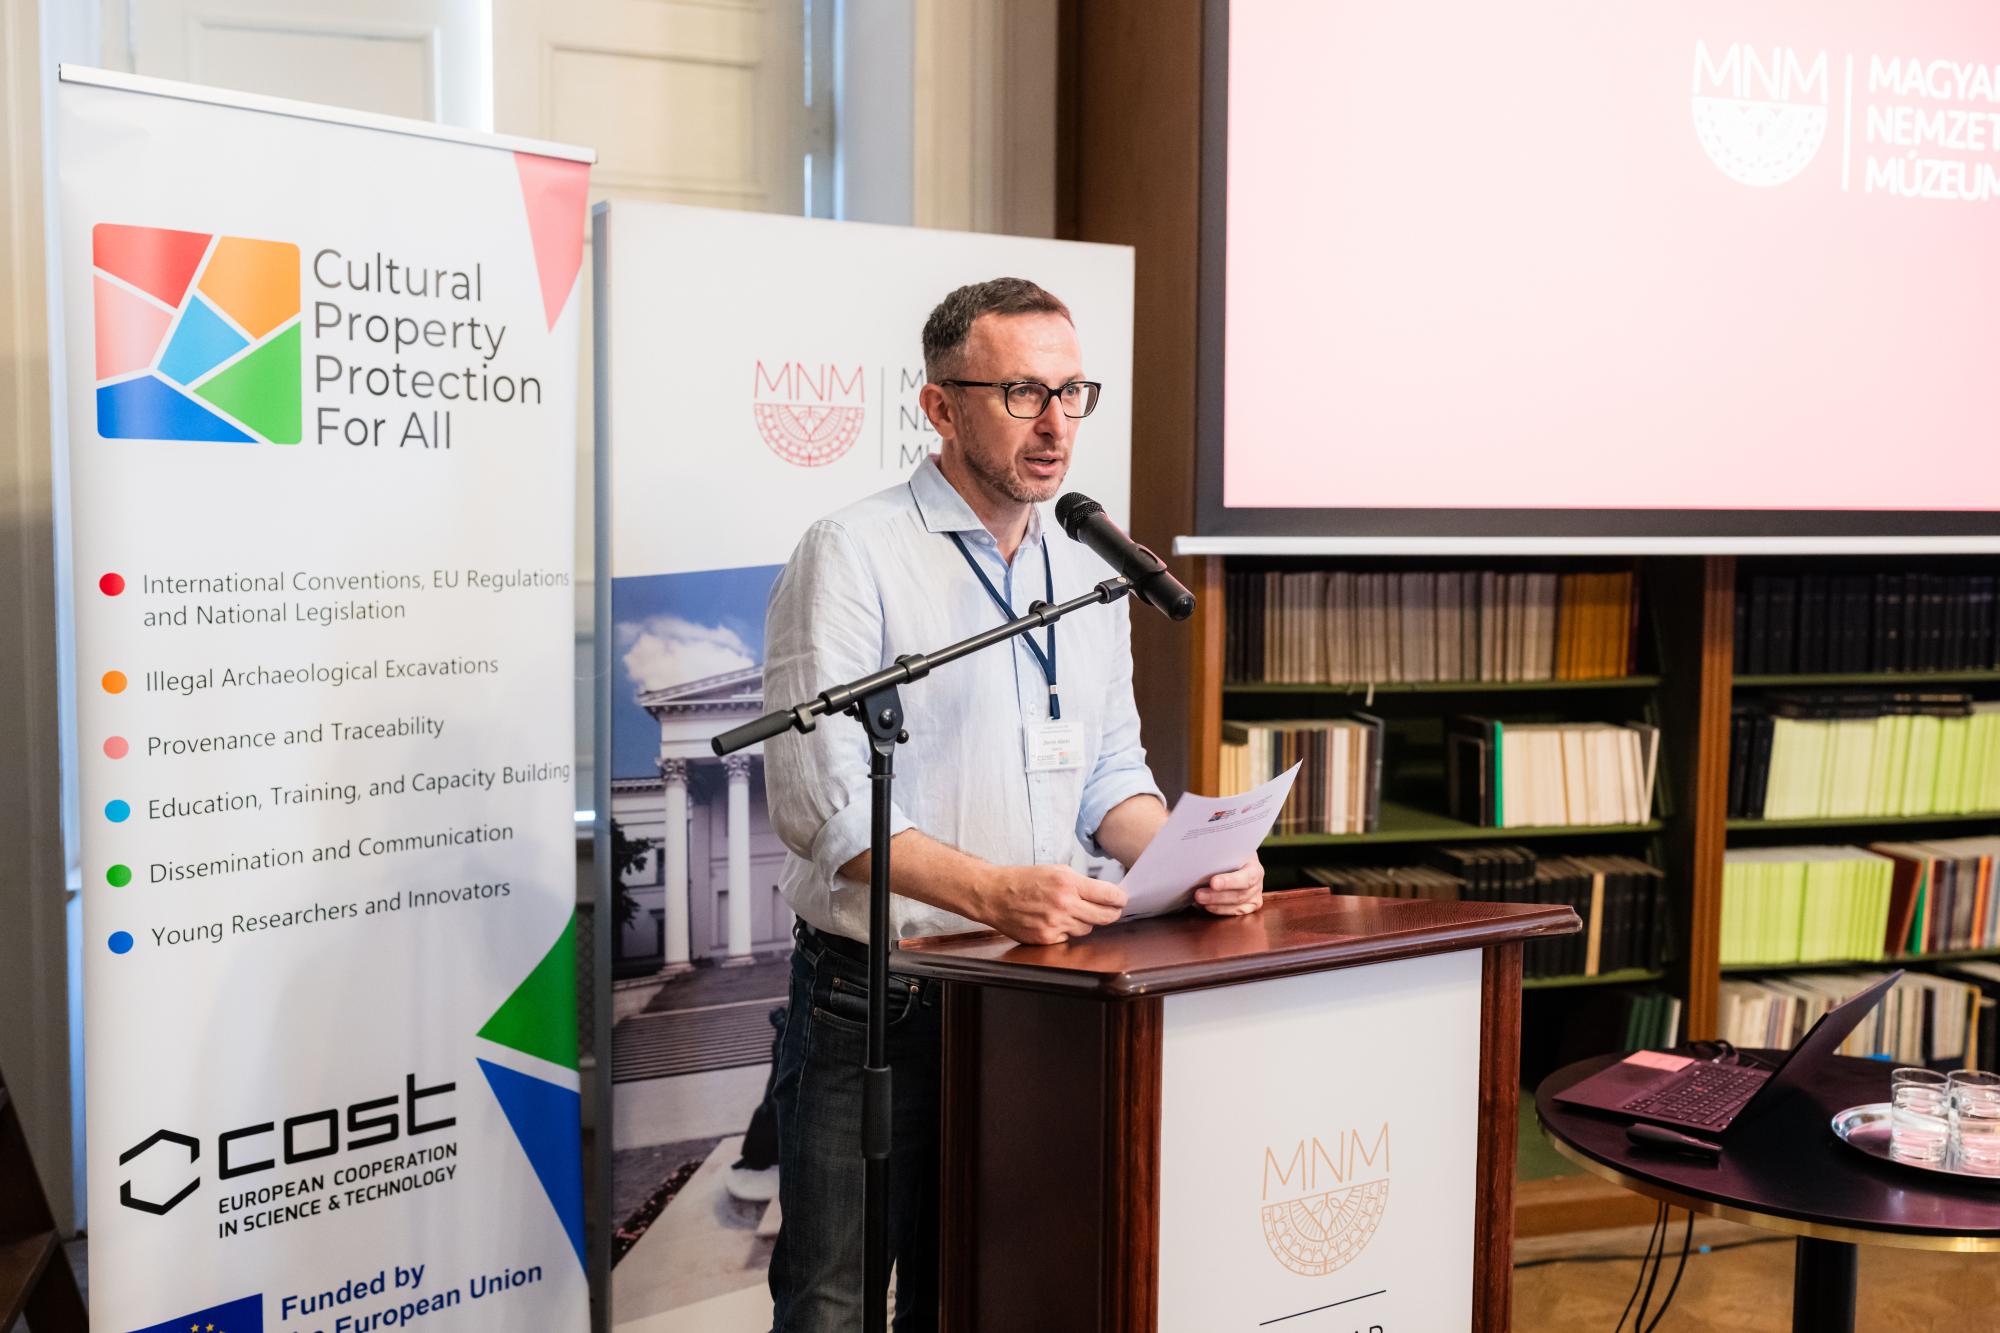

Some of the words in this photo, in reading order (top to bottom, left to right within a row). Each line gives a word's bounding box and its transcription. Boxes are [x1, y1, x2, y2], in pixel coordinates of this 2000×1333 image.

[1692, 39, 1827, 104] MNM
[313, 248, 482, 302] Cultural
[313, 301, 507, 359] Property
[314, 354, 542, 404] Protection
[754, 360, 865, 403] MNM
[316, 408, 387, 447] For
[399, 411, 452, 449] All
[143, 573, 285, 593] International
[292, 571, 425, 590] Conventions,
[433, 570, 459, 588] EU
[466, 569, 569, 591] Regulations
[143, 605, 187, 626] and
[196, 602, 287, 624] National
[295, 600, 406, 625] Legislation
[146, 668, 213, 694] Illegal
[221, 661, 378, 686] Archaeological
[385, 656, 499, 676] Excavations
[147, 729, 276, 755] Provenance
[283, 723, 323, 743] and
[330, 716, 445, 740] Traceability
[148, 792, 263, 819] Education,
[270, 781, 361, 805] Training,
[368, 775, 406, 795] and
[412, 768, 495, 793] Capacity
[503, 761, 570, 783] Building
[150, 848, 304, 883] Dissemination
[312, 839, 351, 860] and
[358, 824, 514, 856] Communication
[151, 919, 224, 946] Young
[232, 899, 358, 933] Researchers
[364, 893, 401, 914] and
[407, 880, 511, 906] Innovators
[219, 1175, 325, 1214] EUROPEAN
[333, 1143, 458, 1186] COOPERATION
[1262, 1121, 1390, 1201] MNM
[219, 1223, 238, 1238] IN
[243, 1200, 321, 1233] SCIENCE
[327, 1195, 340, 1211] &
[345, 1165, 458, 1206] TECHNOLOGY
[281, 1271, 385, 1321] Funded
[394, 1265, 425, 1289] by
[335, 1289, 460, 1333] European
[470, 1265, 542, 1299] Union
